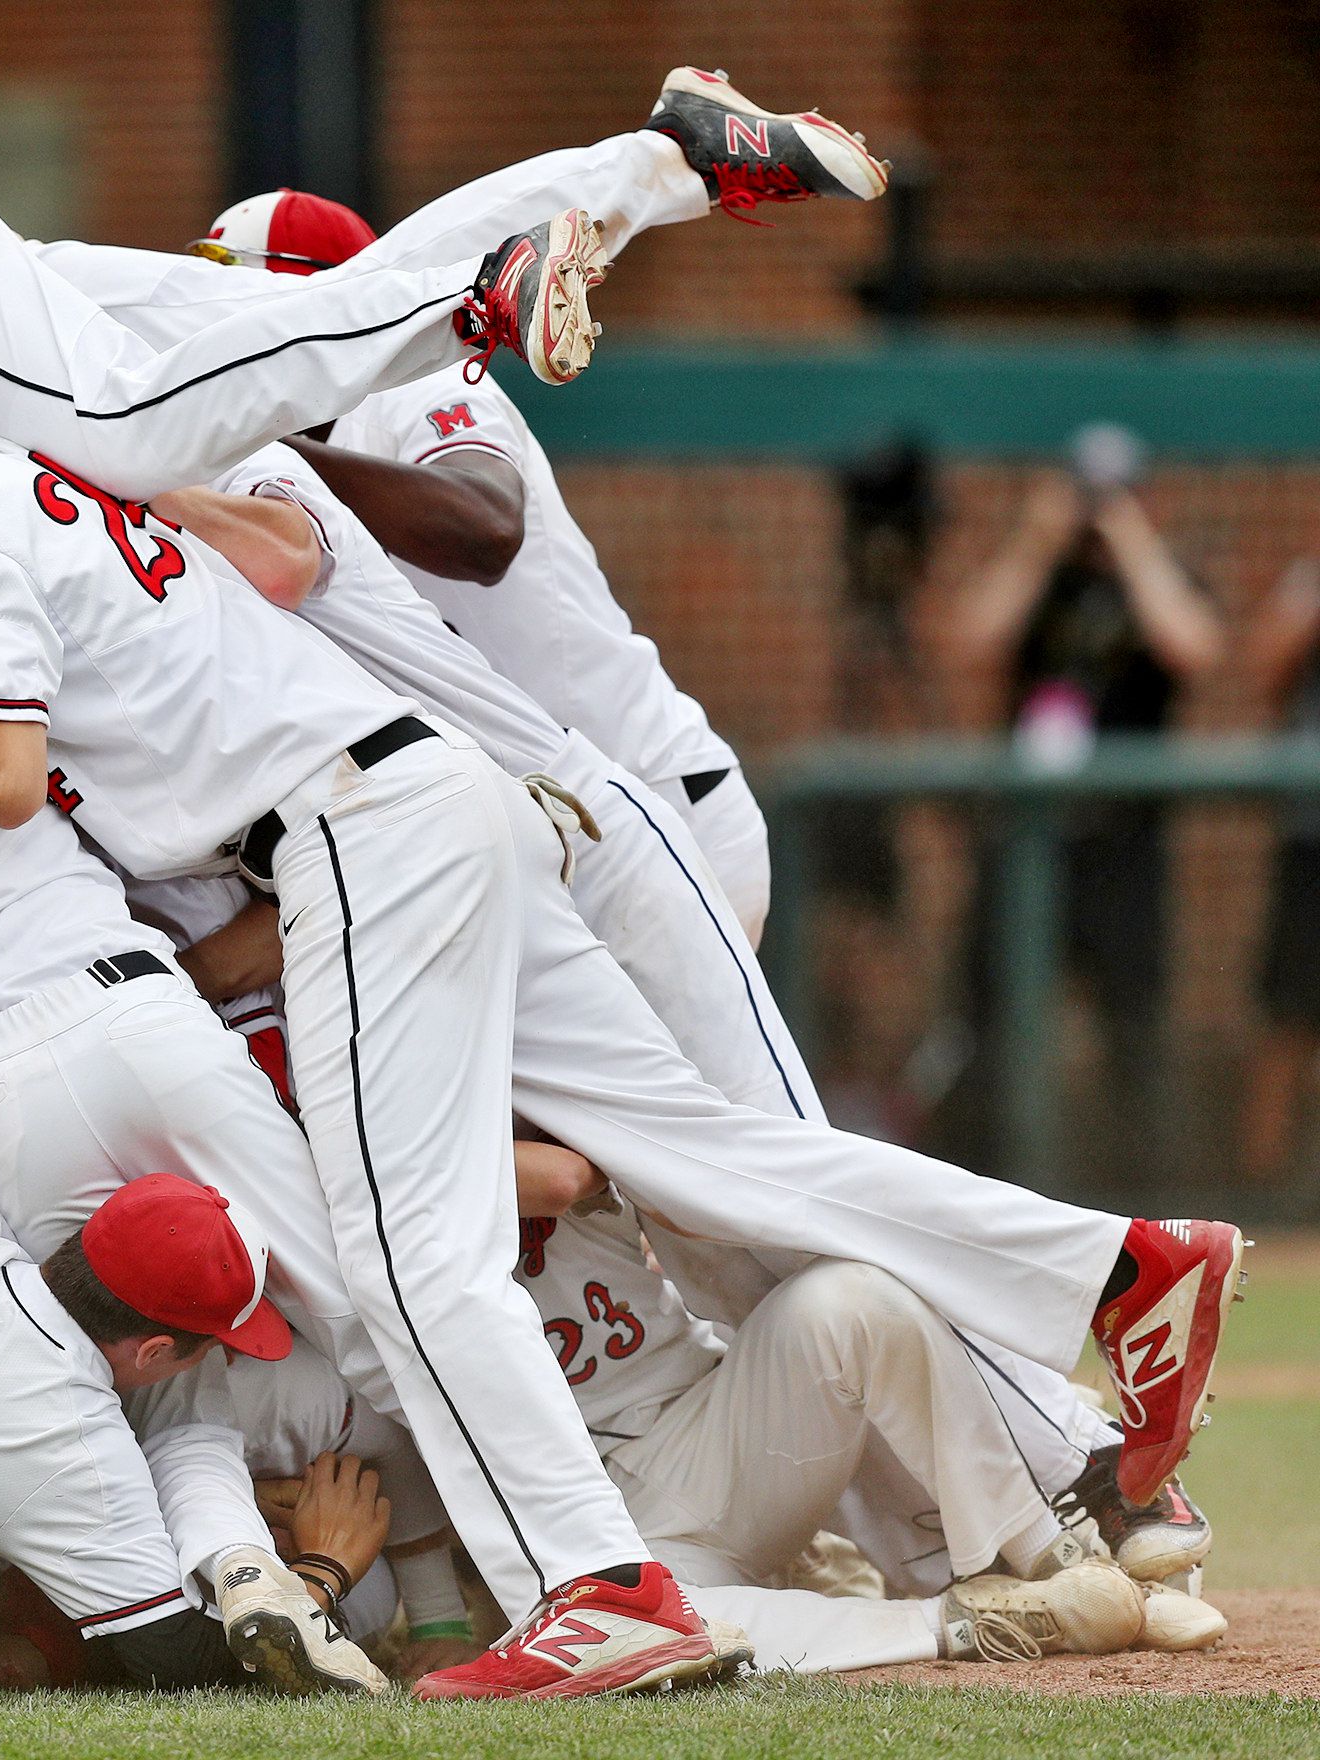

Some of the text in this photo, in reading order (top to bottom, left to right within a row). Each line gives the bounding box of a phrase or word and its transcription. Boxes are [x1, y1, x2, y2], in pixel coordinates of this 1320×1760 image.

[725, 114, 771, 158] N
[426, 403, 477, 440] M
[542, 1281, 645, 1386] 23
[1127, 1321, 1177, 1388] N
[530, 1617, 611, 1667] N
